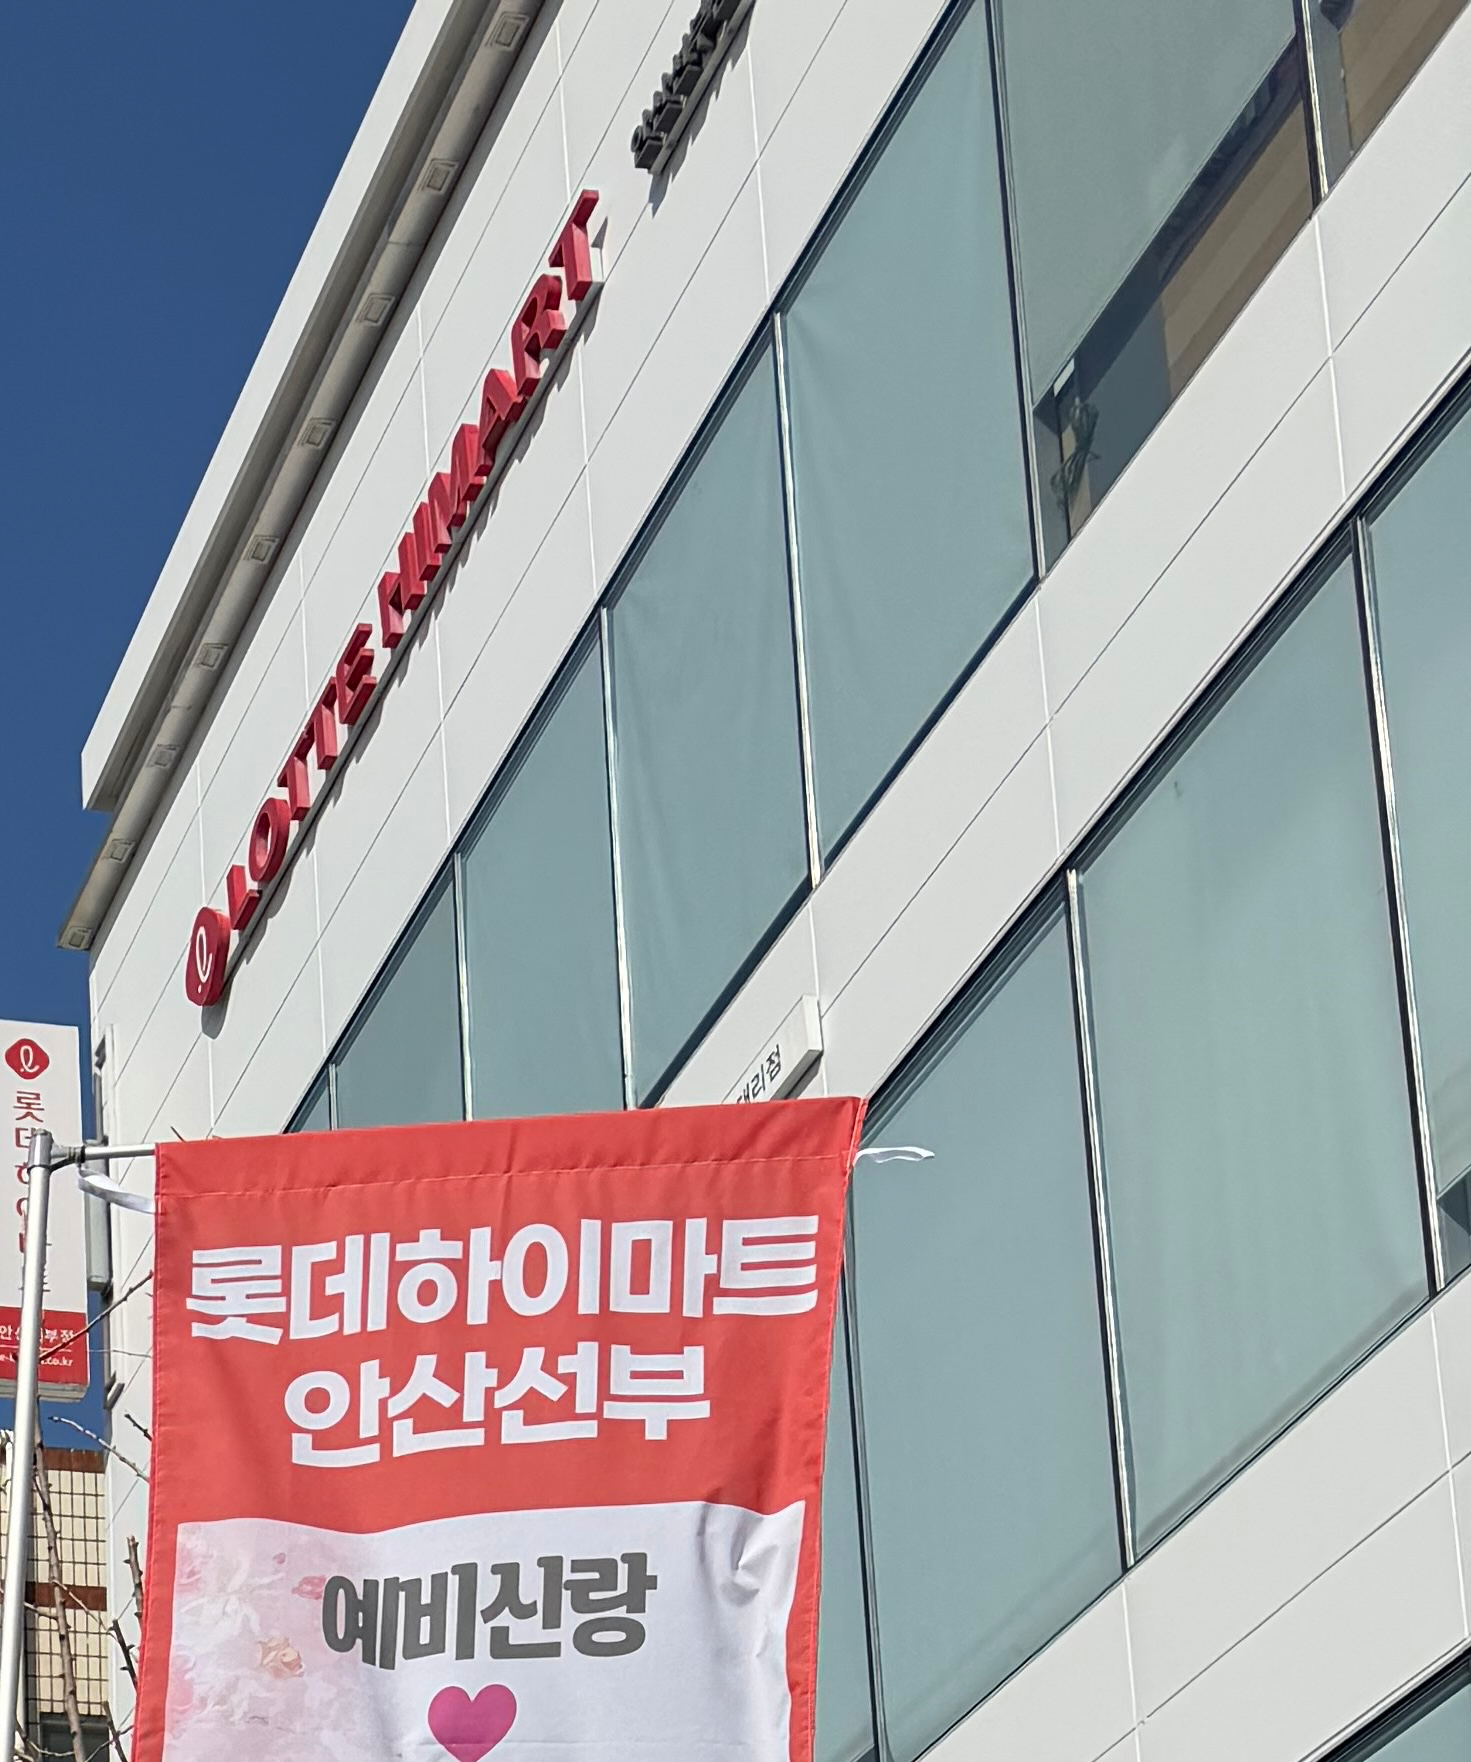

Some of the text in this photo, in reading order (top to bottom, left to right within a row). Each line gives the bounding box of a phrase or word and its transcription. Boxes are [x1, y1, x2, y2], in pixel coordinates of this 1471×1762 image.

[227, 189, 599, 932] LOTTE HIMART
[185, 1213, 821, 1345] 롯데하이마트
[284, 1343, 711, 1468] 안산선부
[322, 1551, 658, 1671] 예비신랑
